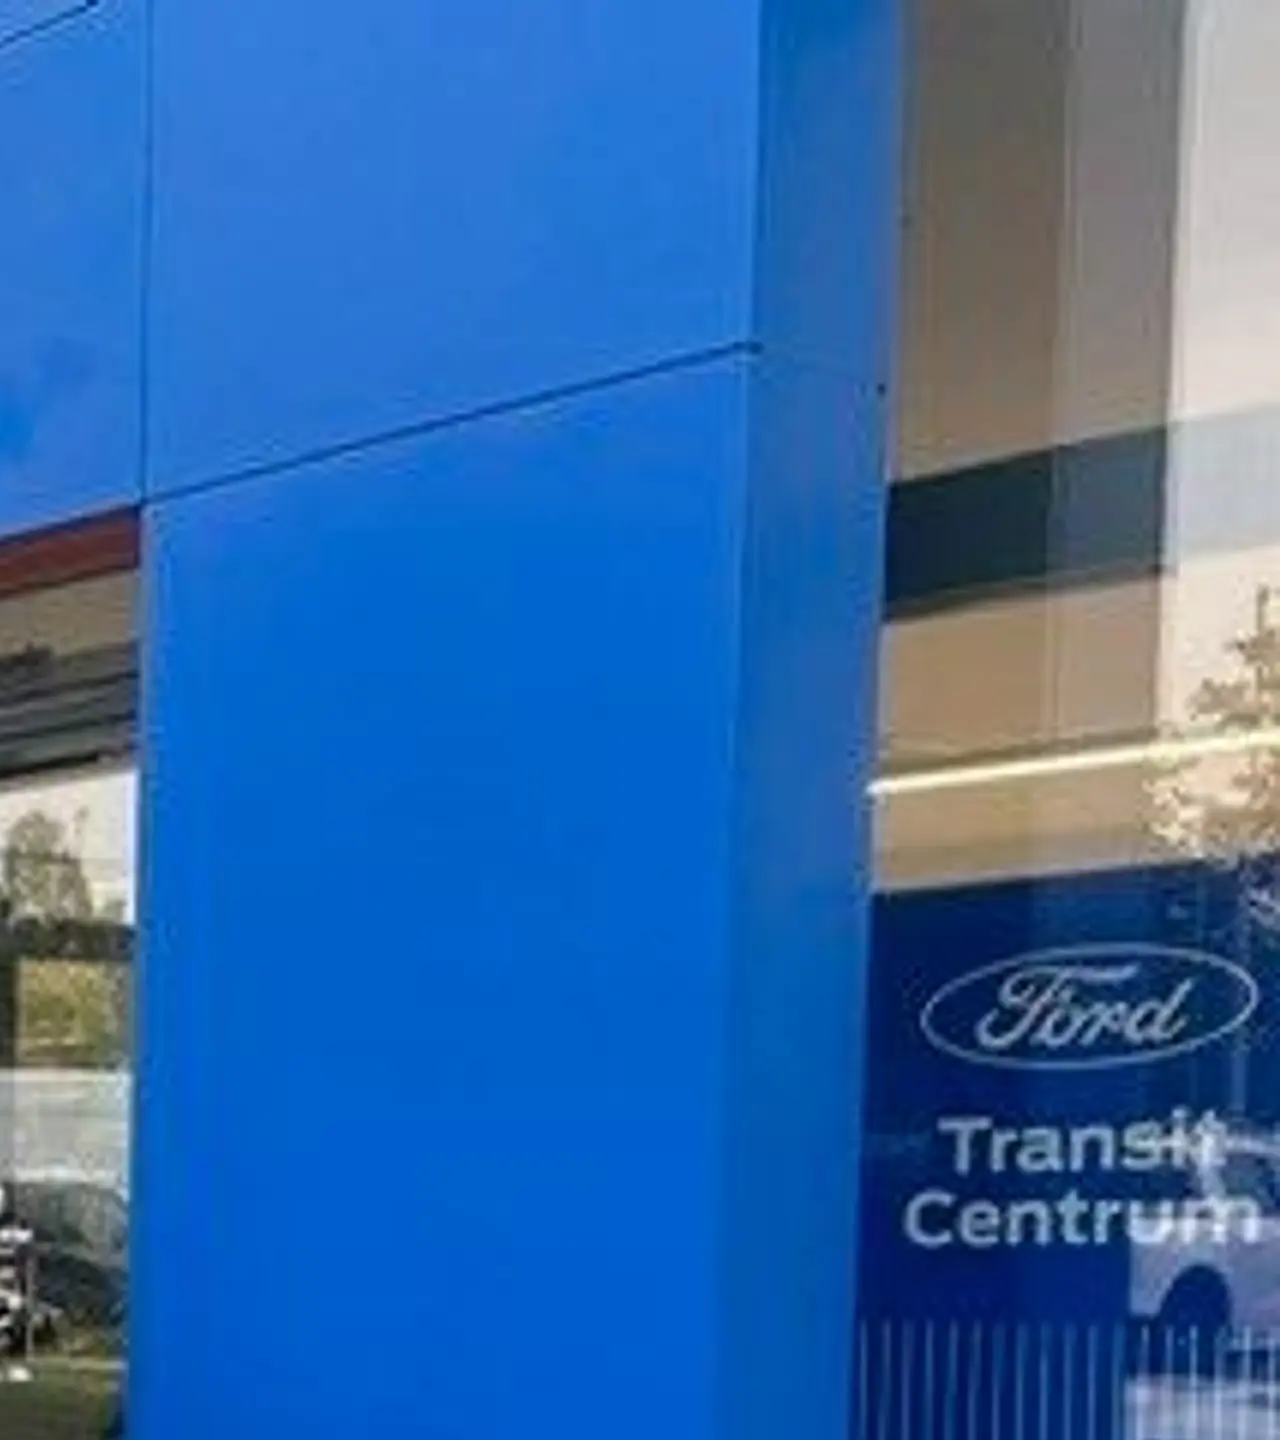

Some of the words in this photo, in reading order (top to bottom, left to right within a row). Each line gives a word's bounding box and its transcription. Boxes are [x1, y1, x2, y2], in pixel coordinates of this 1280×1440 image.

[975, 963, 1194, 1050] Ford
[936, 1105, 1229, 1177] Transit
[903, 1189, 1263, 1250] Centrum
